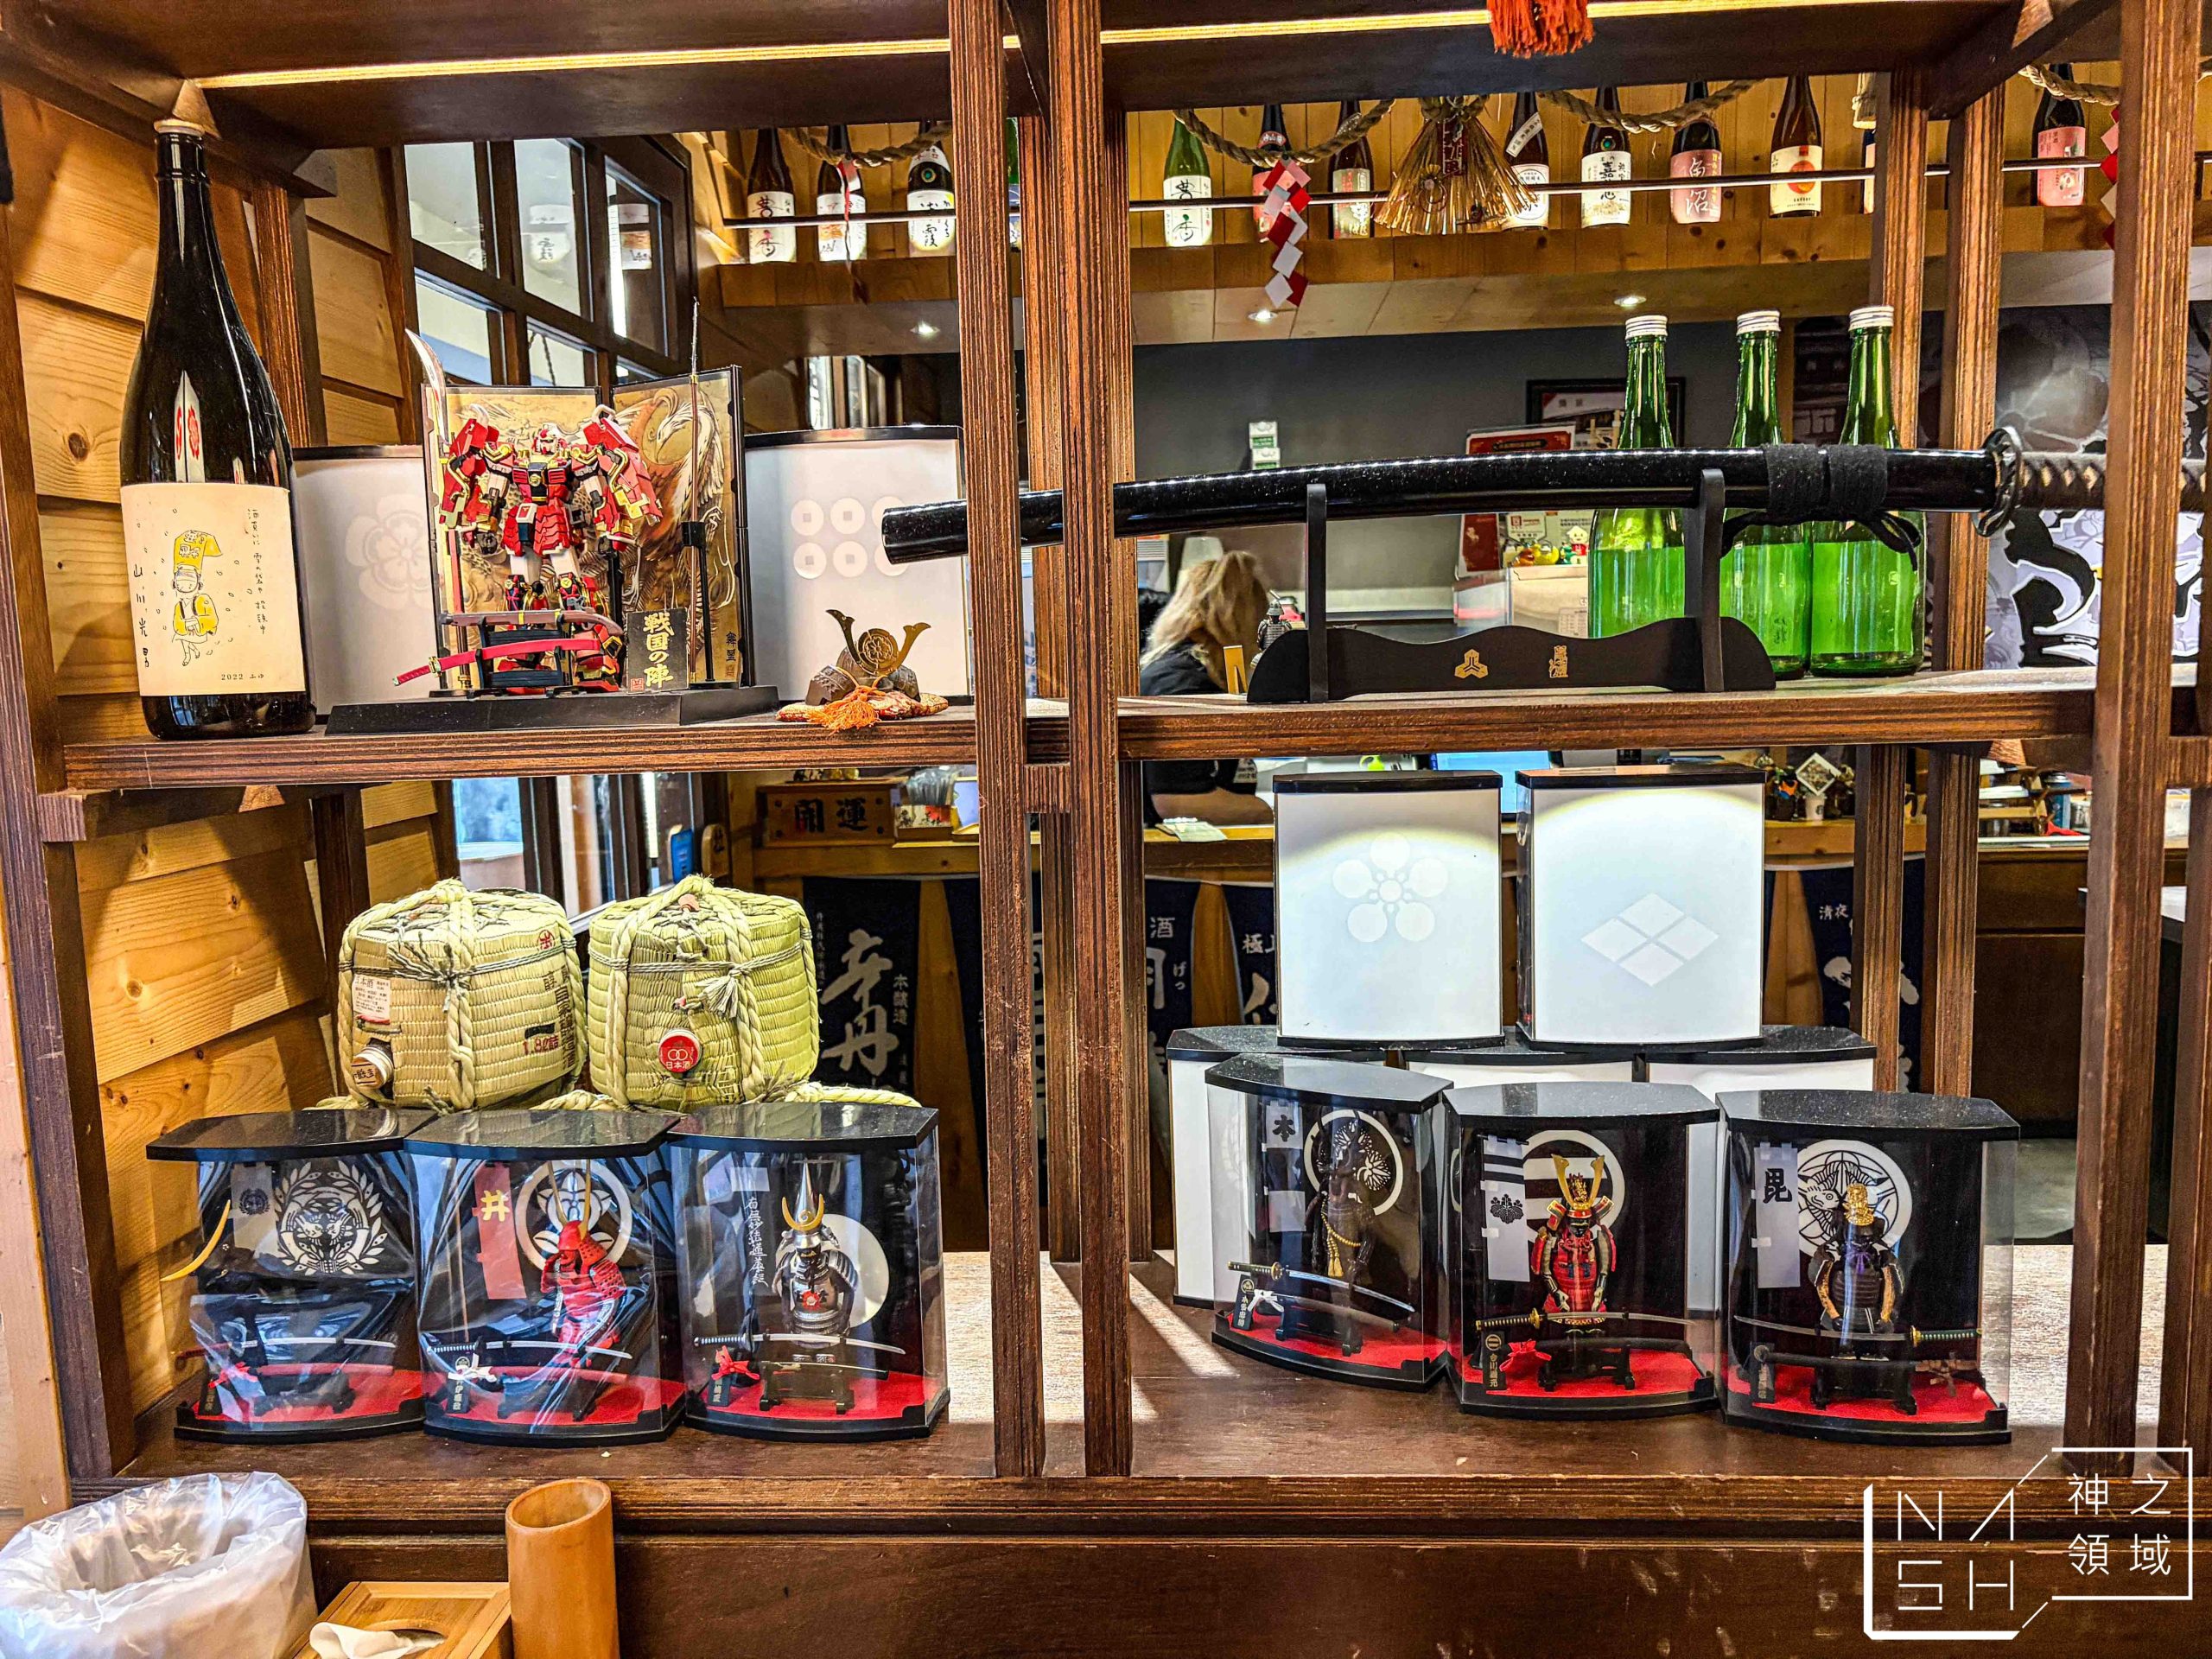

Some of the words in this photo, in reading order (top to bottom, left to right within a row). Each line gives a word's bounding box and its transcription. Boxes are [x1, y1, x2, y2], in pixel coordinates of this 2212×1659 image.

[1599, 161, 1617, 200] 嘉心
[1150, 917, 1174, 938] 酒
[821, 928, 899, 1090] 辛丹
[893, 974, 909, 1026] 本醸造
[666, 1060, 691, 1070] 日本酒
[1272, 1114, 1296, 1142] 本
[1763, 1167, 1793, 1204] 毘
[480, 1190, 510, 1222] 井
